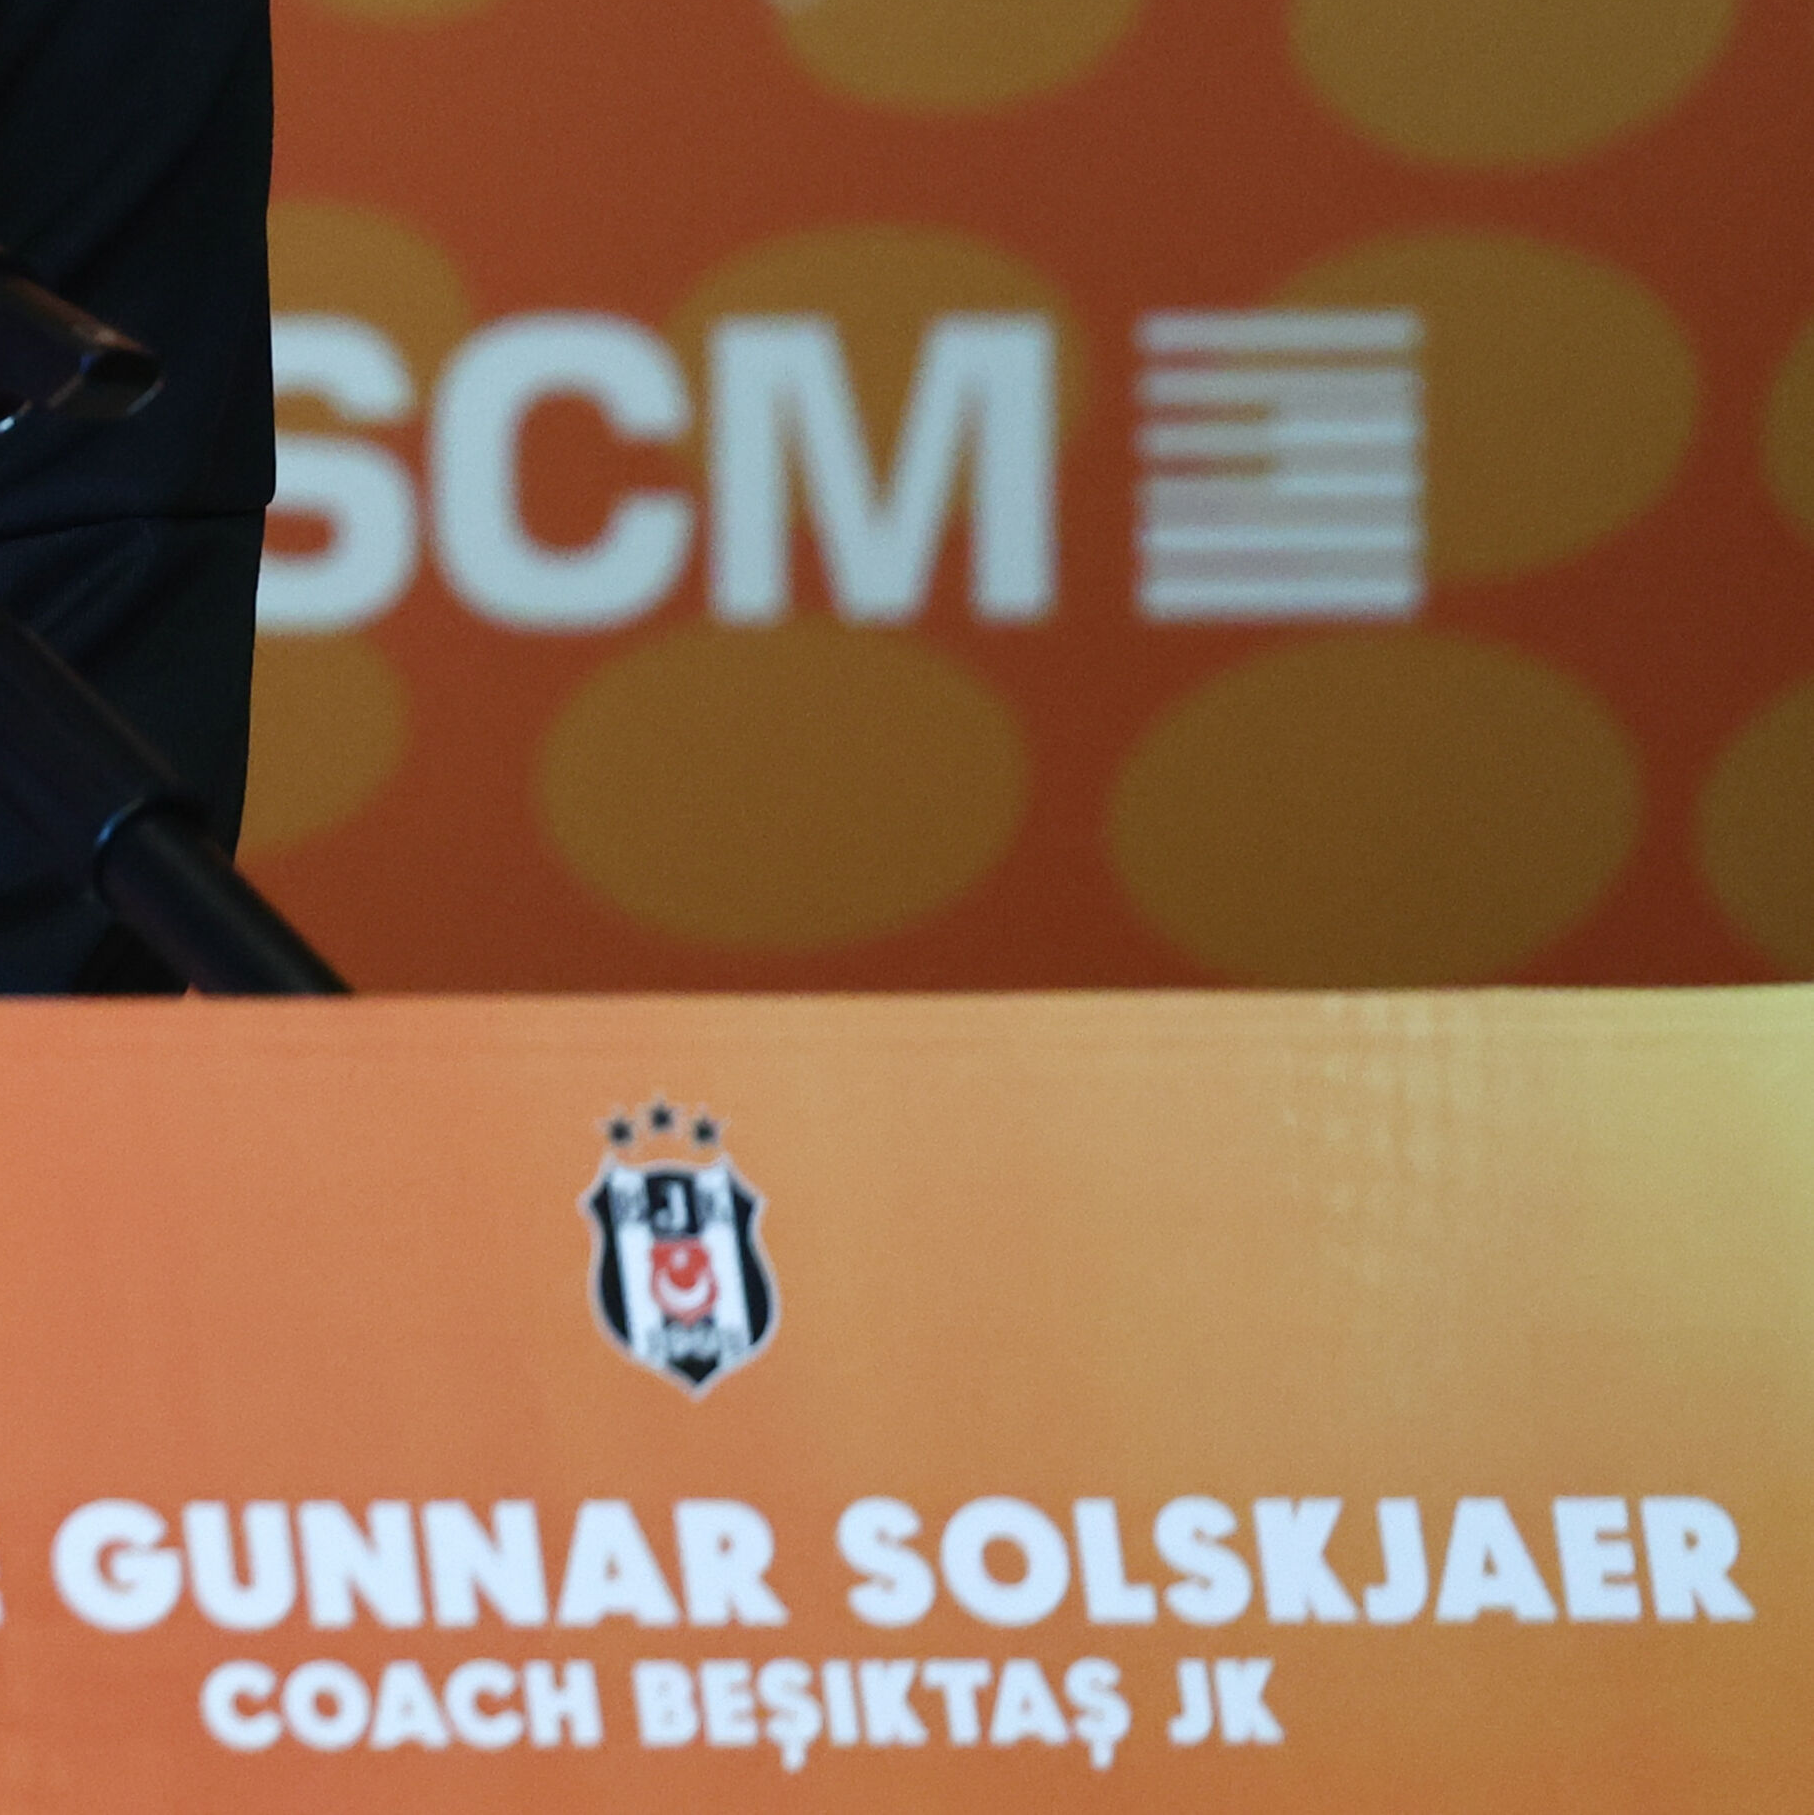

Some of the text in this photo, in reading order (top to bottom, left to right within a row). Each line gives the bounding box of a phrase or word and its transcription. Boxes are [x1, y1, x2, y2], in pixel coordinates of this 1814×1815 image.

[257, 310, 1057, 632] SCM
[51, 1498, 787, 1631] GUNNAR
[836, 1495, 1756, 1627] SOLSKJAER
[200, 1655, 1284, 1773] COACH BEŞIKTAŞ JK
